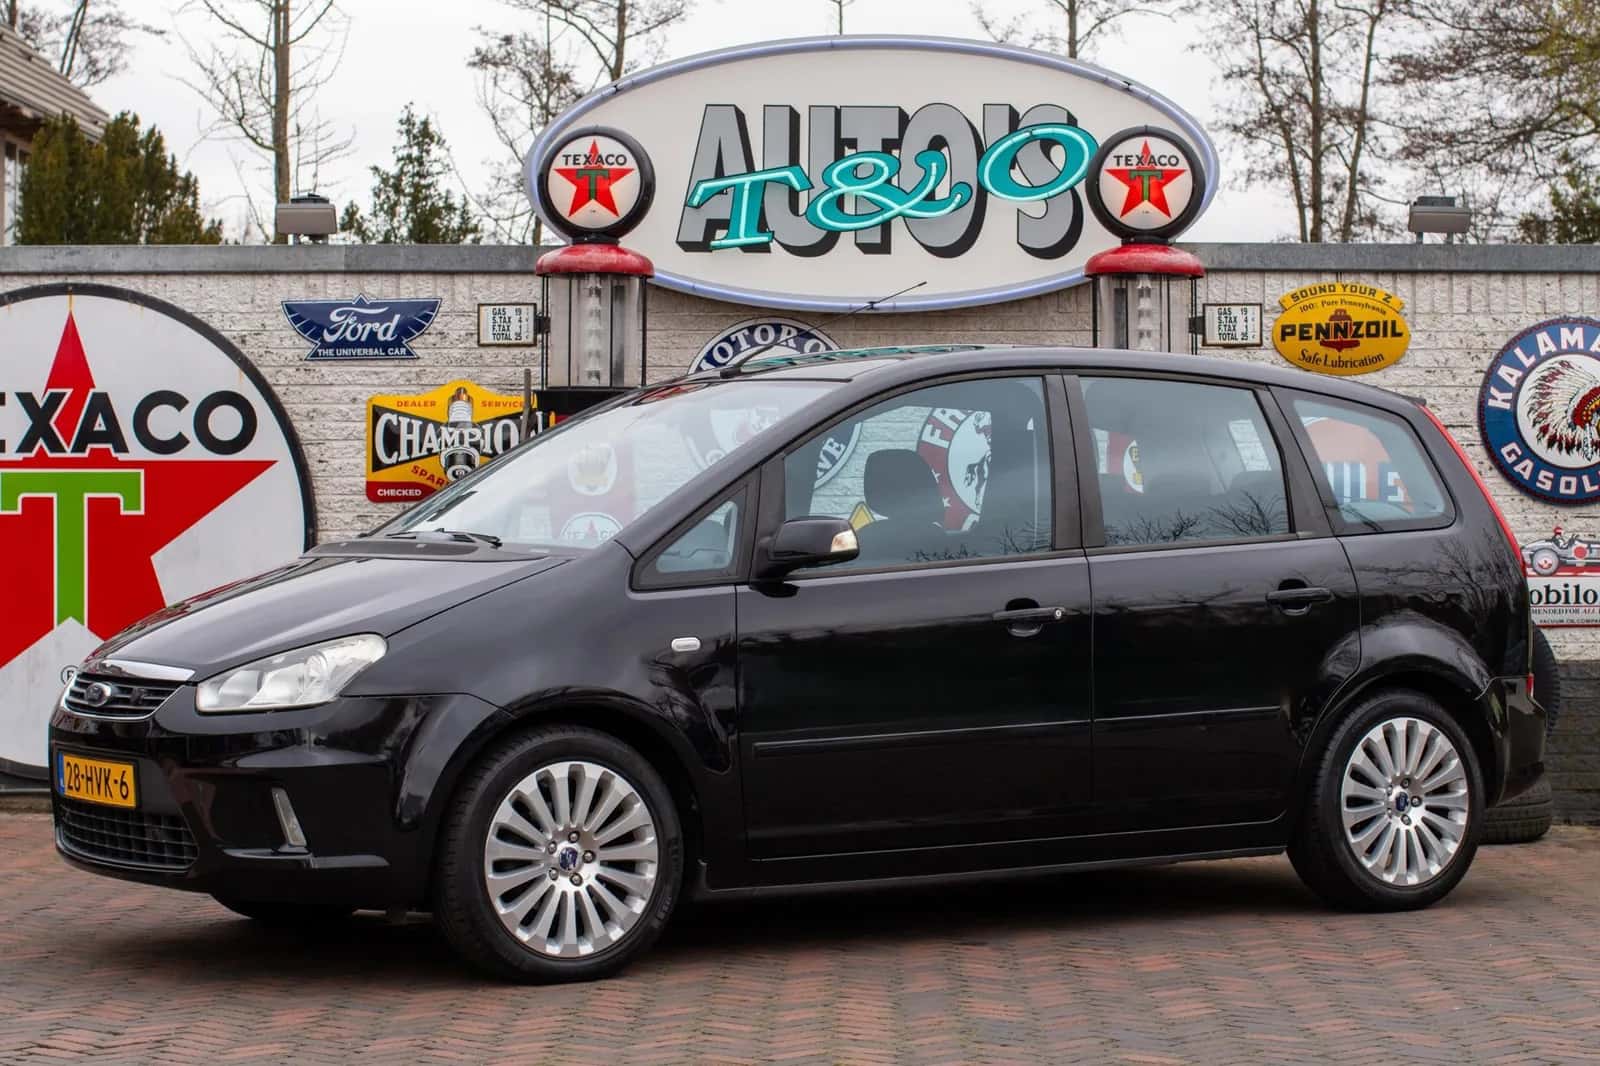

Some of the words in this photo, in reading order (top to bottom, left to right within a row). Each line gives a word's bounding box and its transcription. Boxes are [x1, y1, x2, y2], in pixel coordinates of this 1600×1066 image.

[562, 154, 628, 166] TEXACO
[1113, 154, 1180, 167] TEXACO
[676, 103, 1083, 259] AUTO'S
[1291, 284, 1336, 302] SOUND
[1340, 284, 1377, 297] YOUR
[1382, 293, 1393, 304] Z
[492, 307, 506, 316] GAS
[1217, 307, 1232, 316] GAS
[1340, 298, 1387, 316] Pennsylvania
[322, 306, 401, 343] Ford
[1280, 319, 1404, 342] PENNZOIL
[492, 333, 513, 341] TOTAL
[1217, 333, 1239, 341] TOTAL
[317, 348, 335, 357] THE
[335, 348, 385, 356] UNIVERSAL
[387, 347, 407, 356] CAR
[1299, 348, 1322, 366] Safe
[1323, 352, 1385, 369] Lubrication
[396, 400, 437, 408] DEALER
[0, 389, 258, 455] XACO
[411, 464, 446, 487] SPAR
[1500, 441, 1600, 496] GASOL
[377, 488, 422, 497] CHECKED
[1529, 583, 1600, 605] obilo
[65, 761, 129, 800] 28-HVK-6
